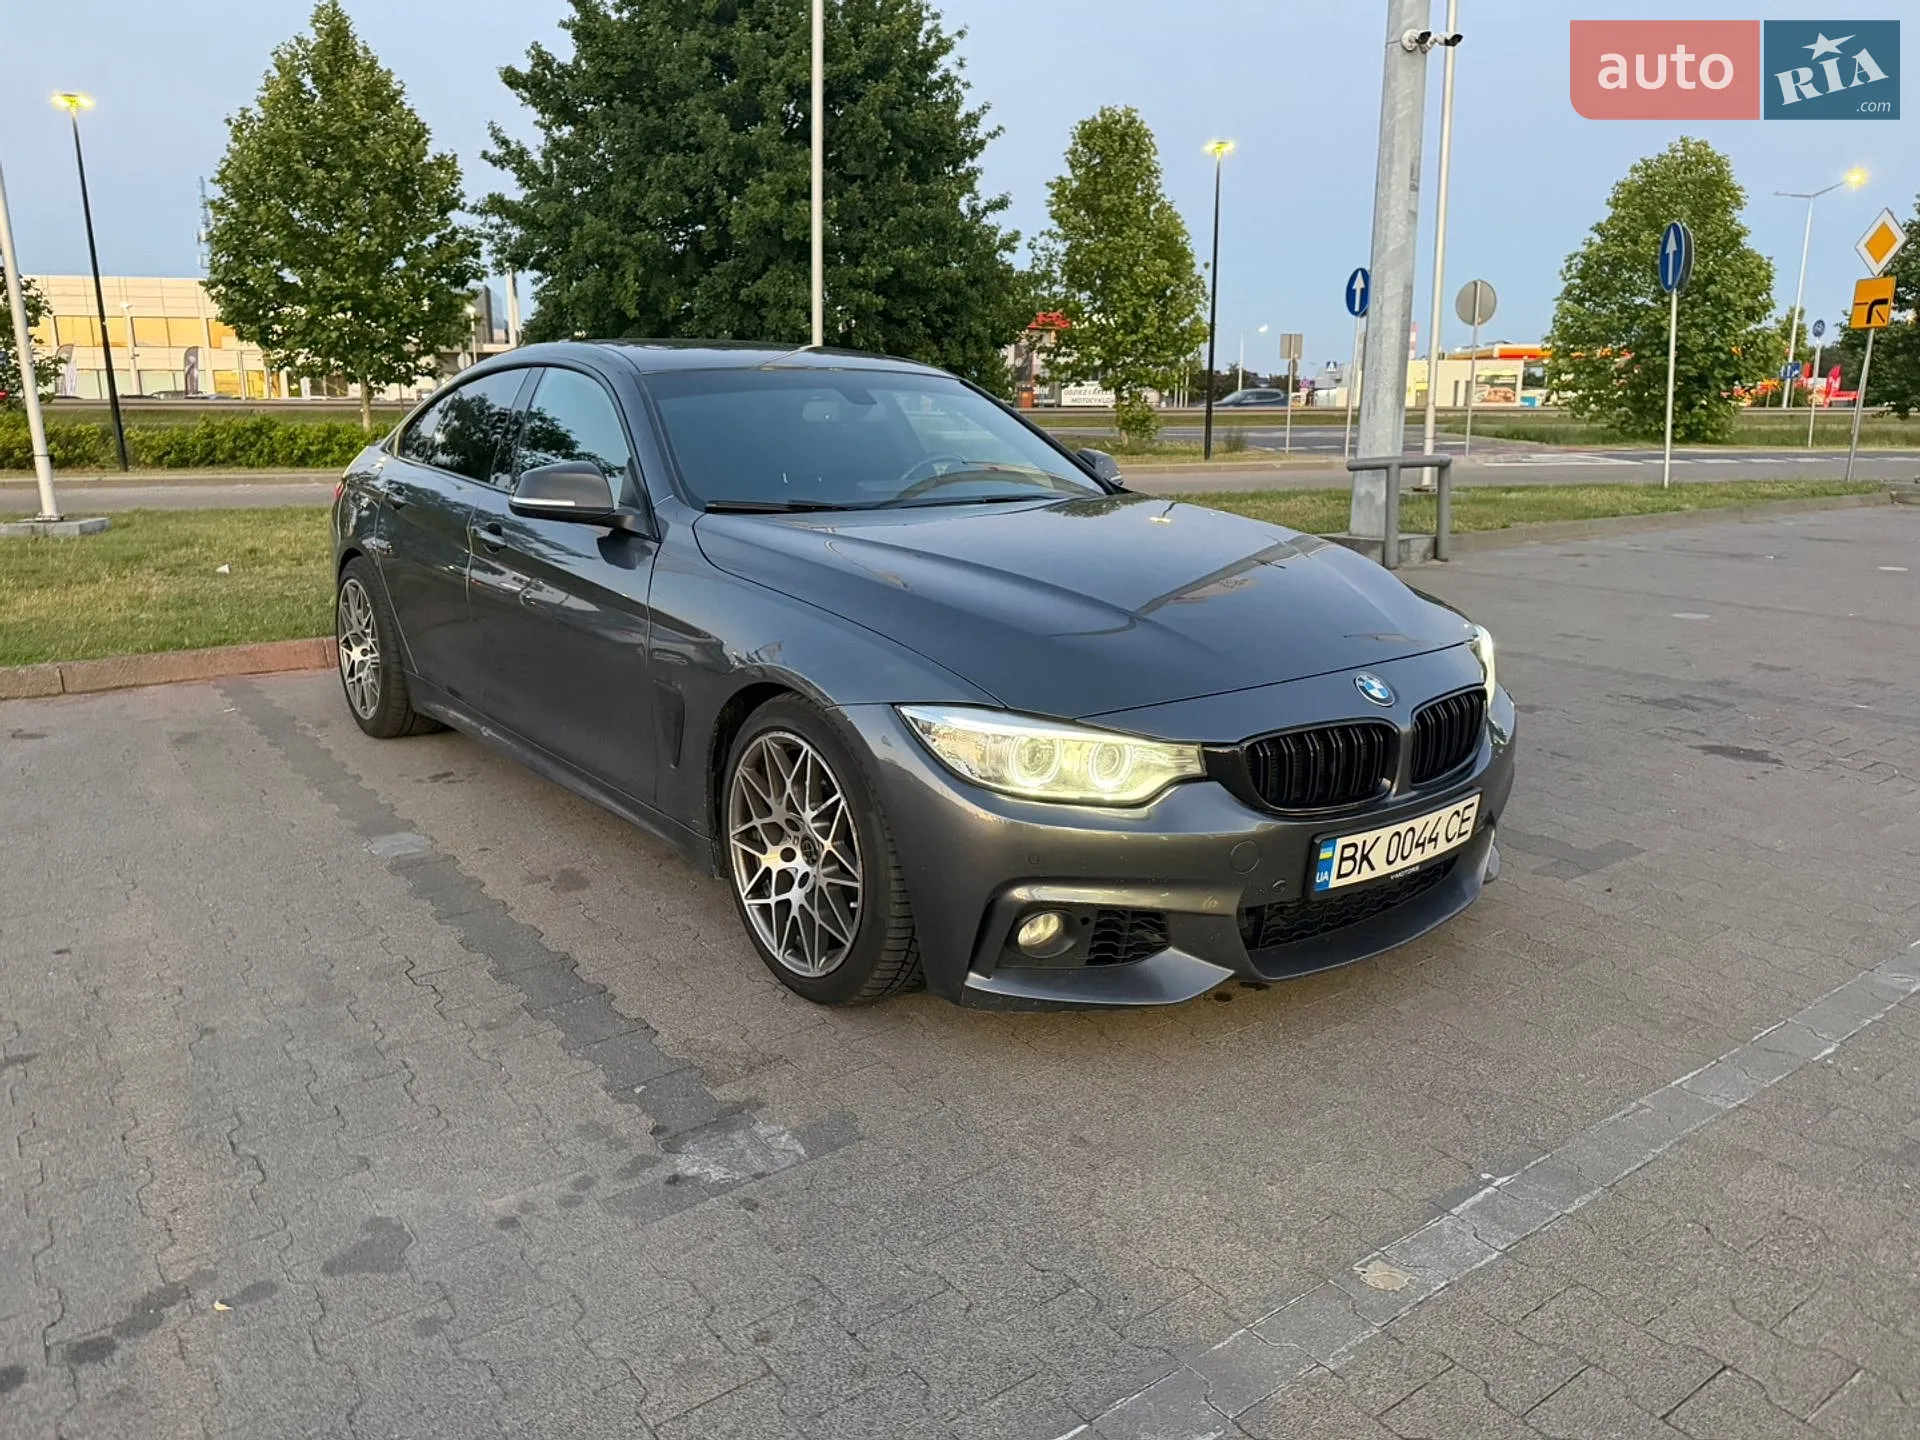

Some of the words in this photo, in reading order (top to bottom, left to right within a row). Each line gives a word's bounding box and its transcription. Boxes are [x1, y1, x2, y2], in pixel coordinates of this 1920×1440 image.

[1336, 836, 1381, 880] BK
[1385, 816, 1442, 866] 0044
[1444, 802, 1475, 844] CE
[1316, 871, 1329, 883] UA
